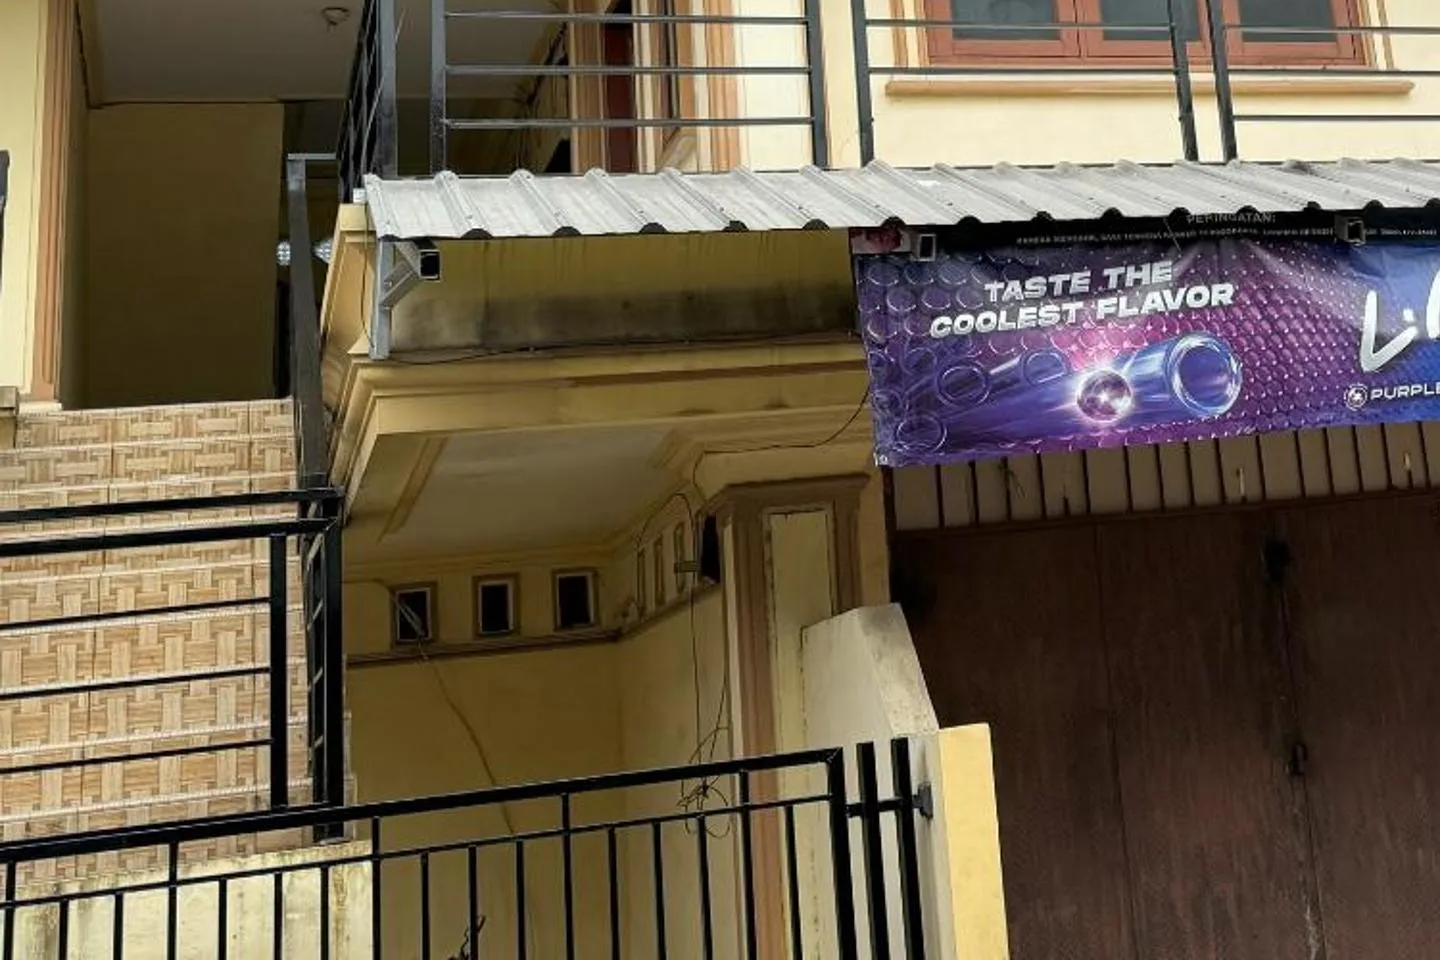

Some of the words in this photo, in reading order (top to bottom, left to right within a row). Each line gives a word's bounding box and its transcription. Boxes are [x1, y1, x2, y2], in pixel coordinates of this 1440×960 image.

[984, 270, 1091, 304] TASTE
[1103, 260, 1173, 289] THE
[929, 302, 1085, 339] COOLEST
[1097, 283, 1235, 320] FLAVOR
